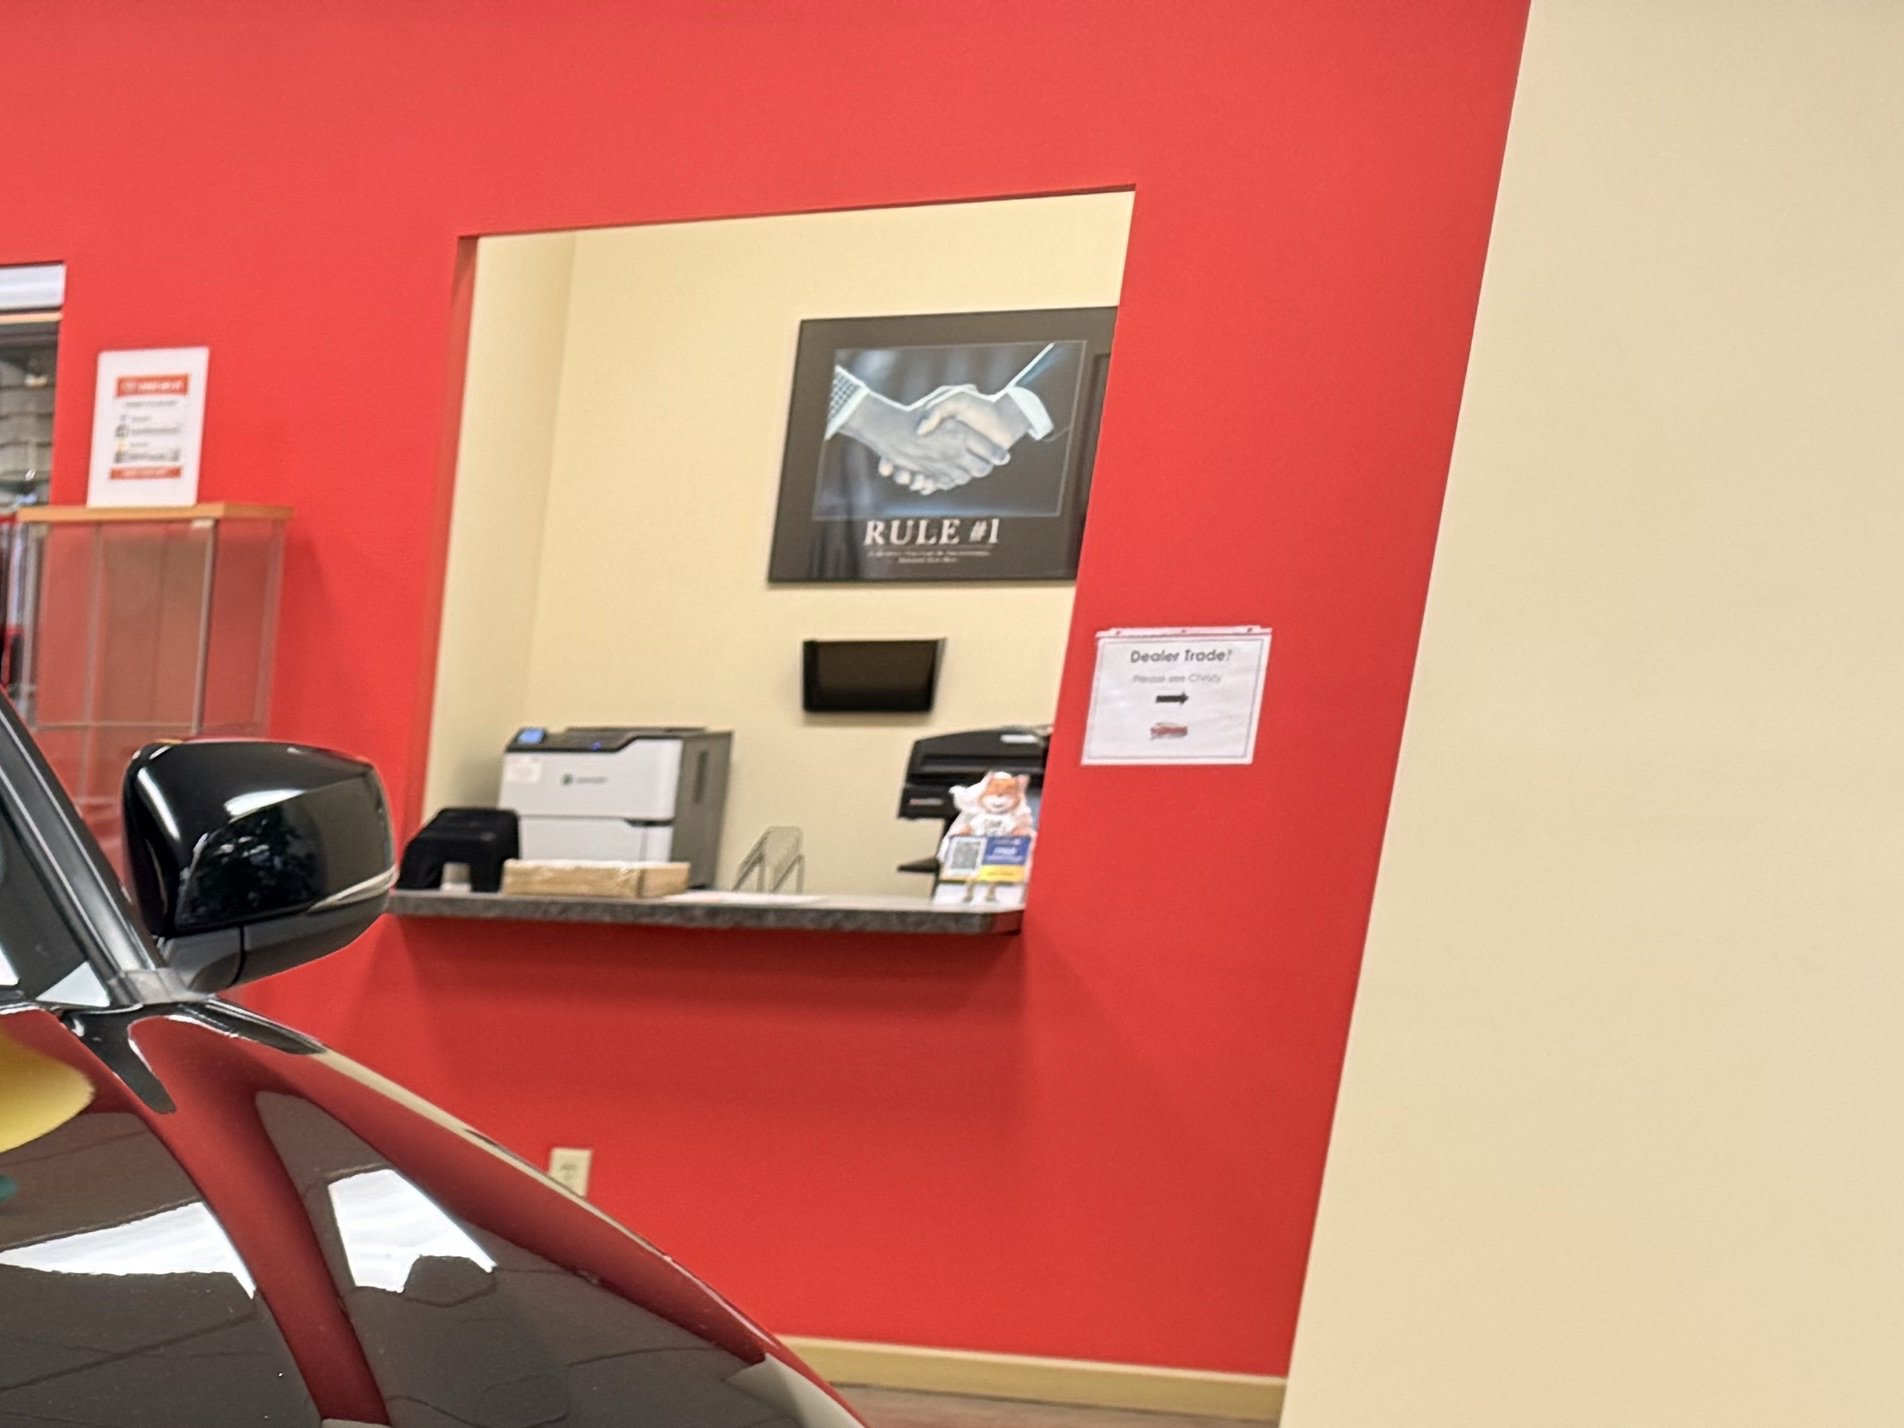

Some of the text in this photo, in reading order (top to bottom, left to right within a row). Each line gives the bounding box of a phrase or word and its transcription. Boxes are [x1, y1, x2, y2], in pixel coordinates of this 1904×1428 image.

[863, 518, 1000, 546] RULE #1
[1130, 649, 1180, 663] Dealer
